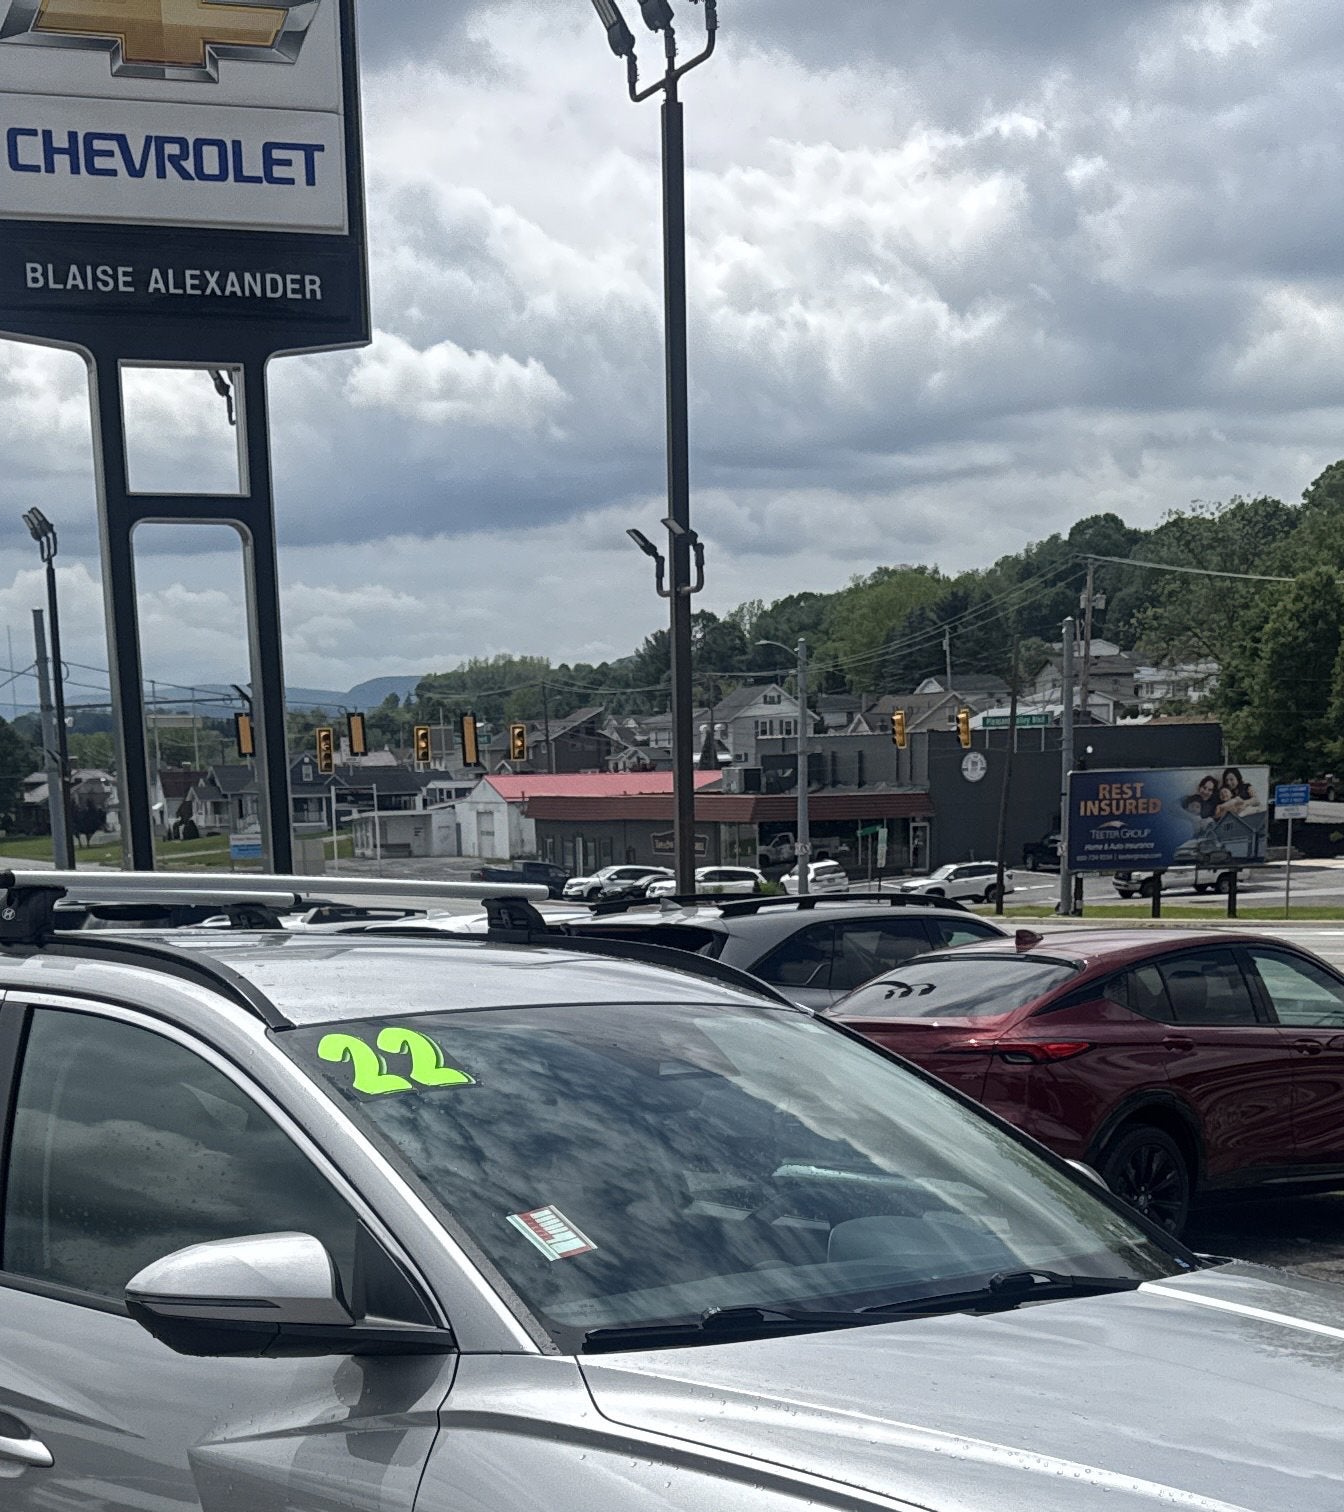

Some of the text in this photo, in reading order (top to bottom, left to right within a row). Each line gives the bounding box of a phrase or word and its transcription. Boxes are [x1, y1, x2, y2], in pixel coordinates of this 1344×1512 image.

[7, 127, 325, 186] CHEVROLET
[25, 262, 322, 300] BLAISE ALEXANDER
[1079, 799, 1163, 816] INSURED
[1098, 782, 1144, 799] REST
[317, 1027, 476, 1096] 22
